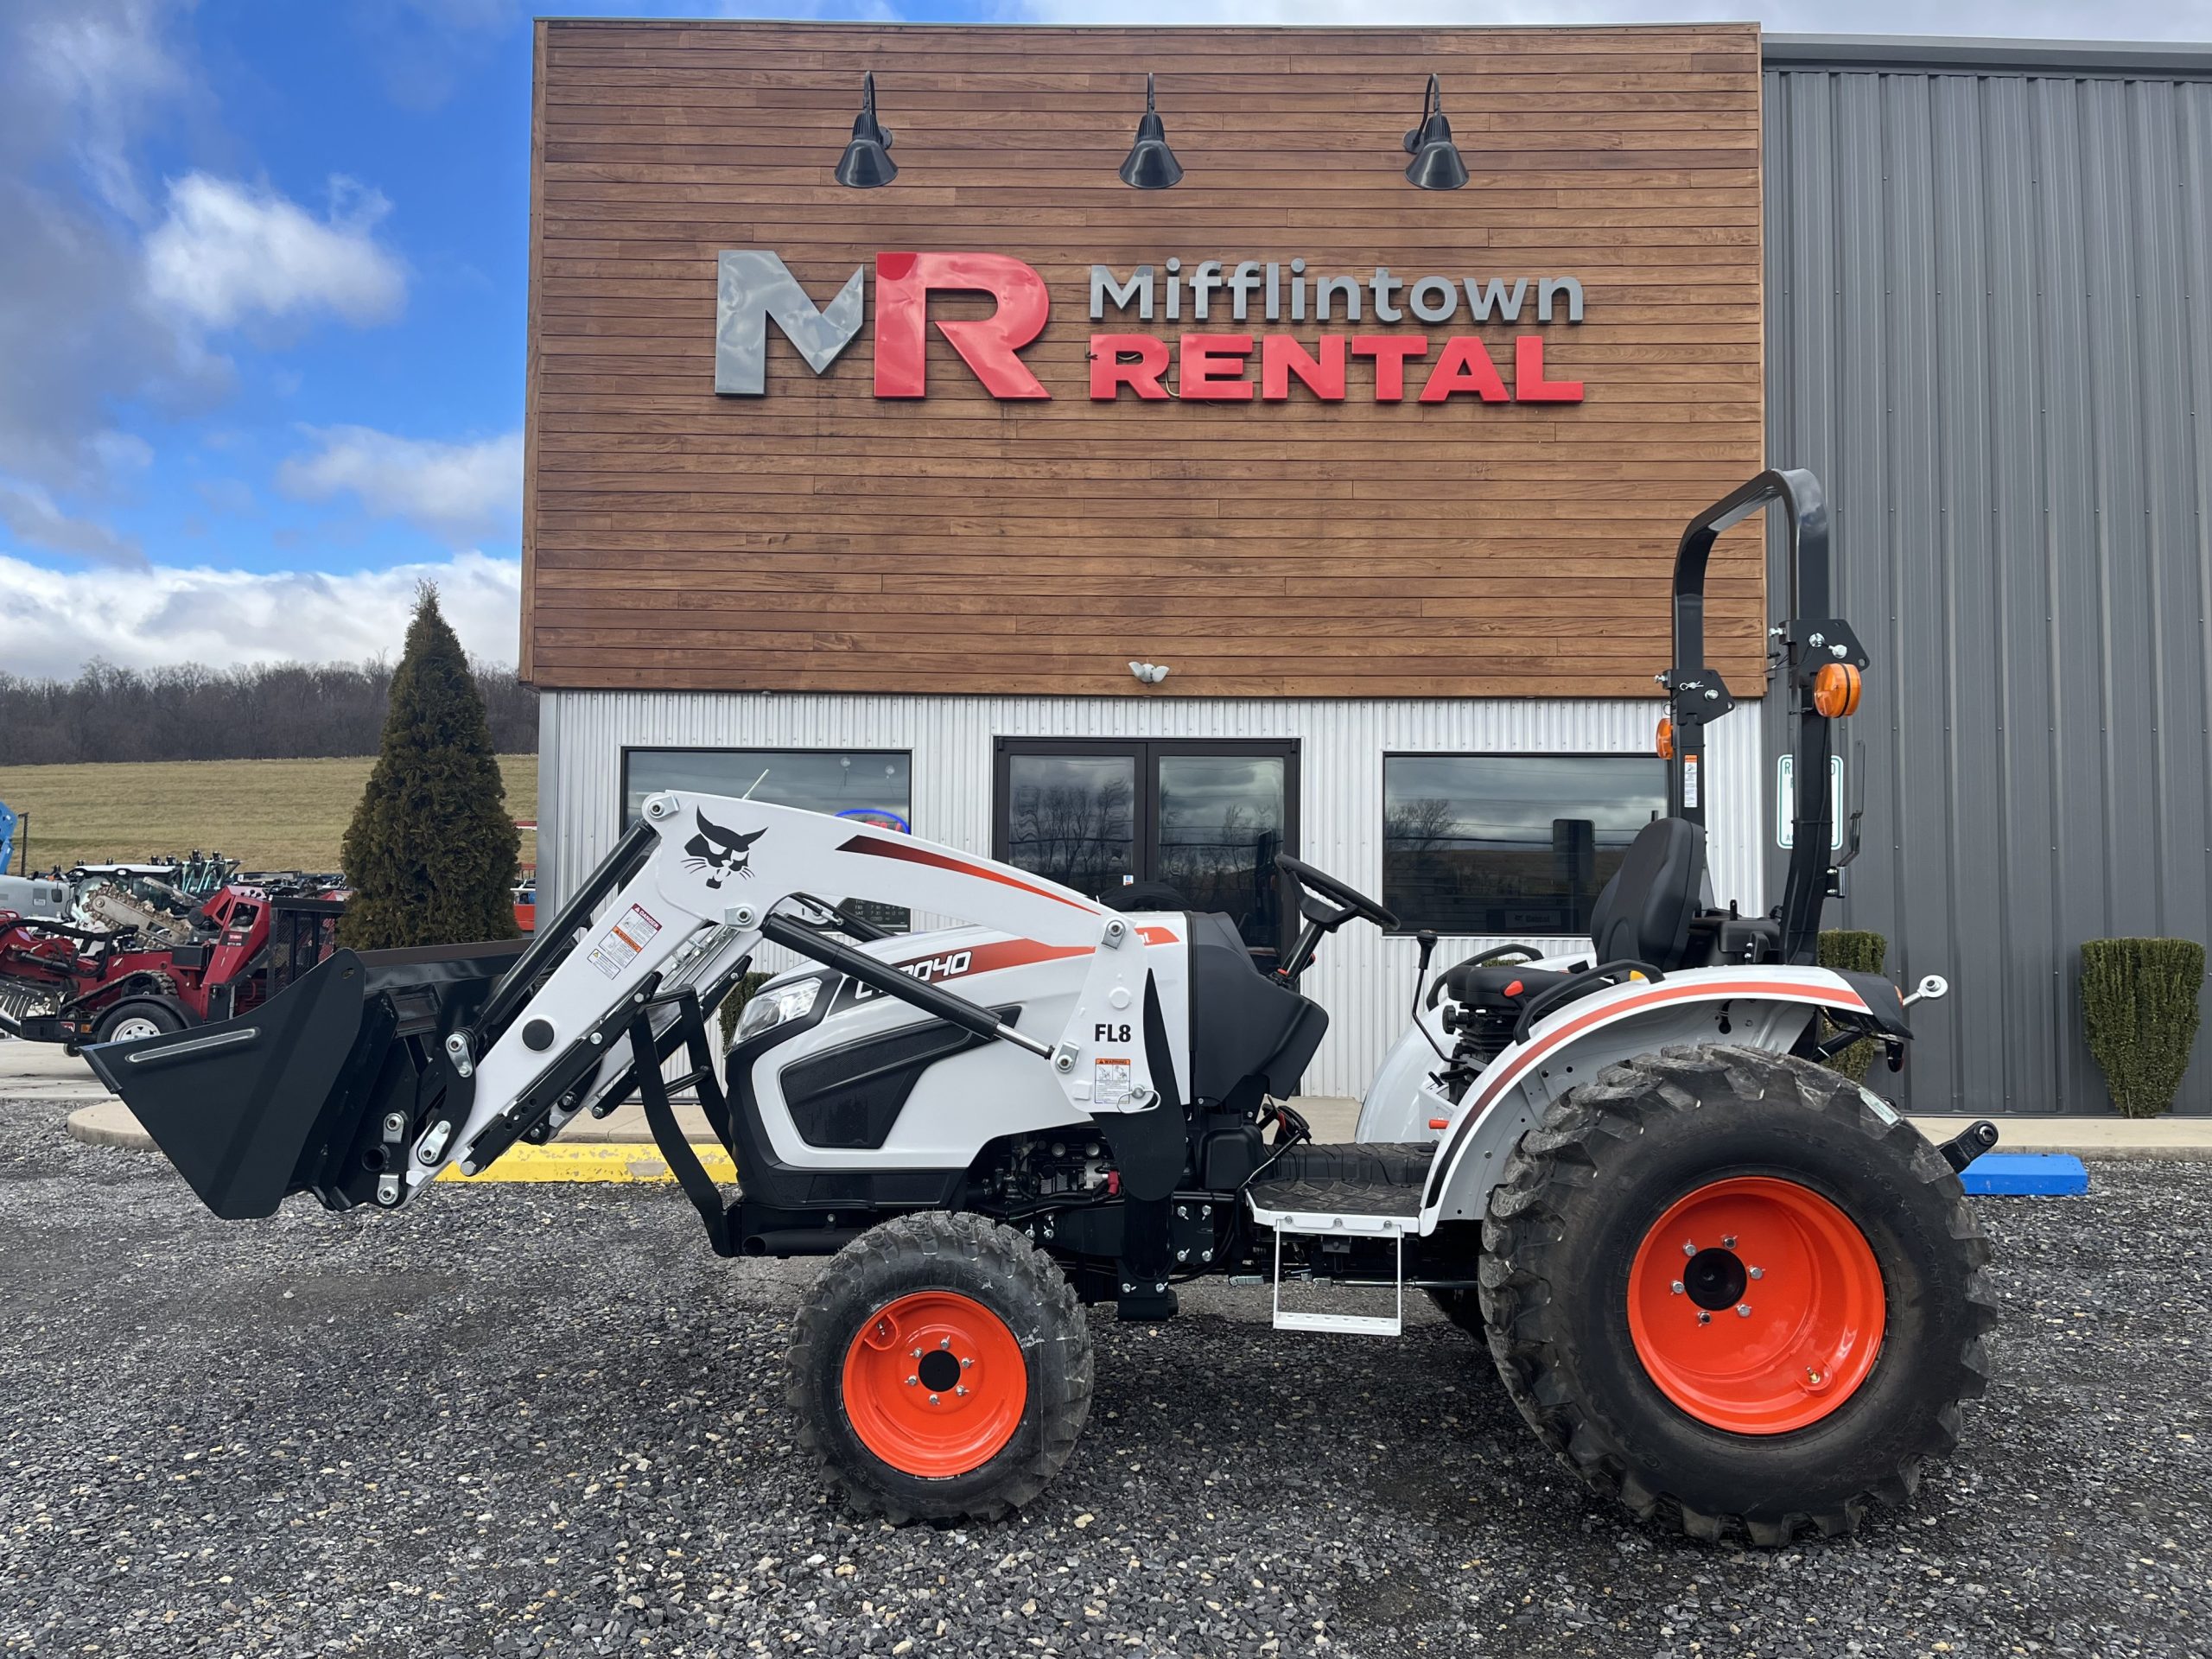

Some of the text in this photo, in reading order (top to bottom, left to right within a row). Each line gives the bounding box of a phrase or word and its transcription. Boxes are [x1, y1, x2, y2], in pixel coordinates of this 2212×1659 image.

[1090, 257, 1584, 324] Mifflintown
[715, 250, 1052, 400] MR
[1090, 334, 1584, 403] RENTAL
[639, 910, 659, 928] DANGER
[1095, 1023, 1131, 1042] FL8
